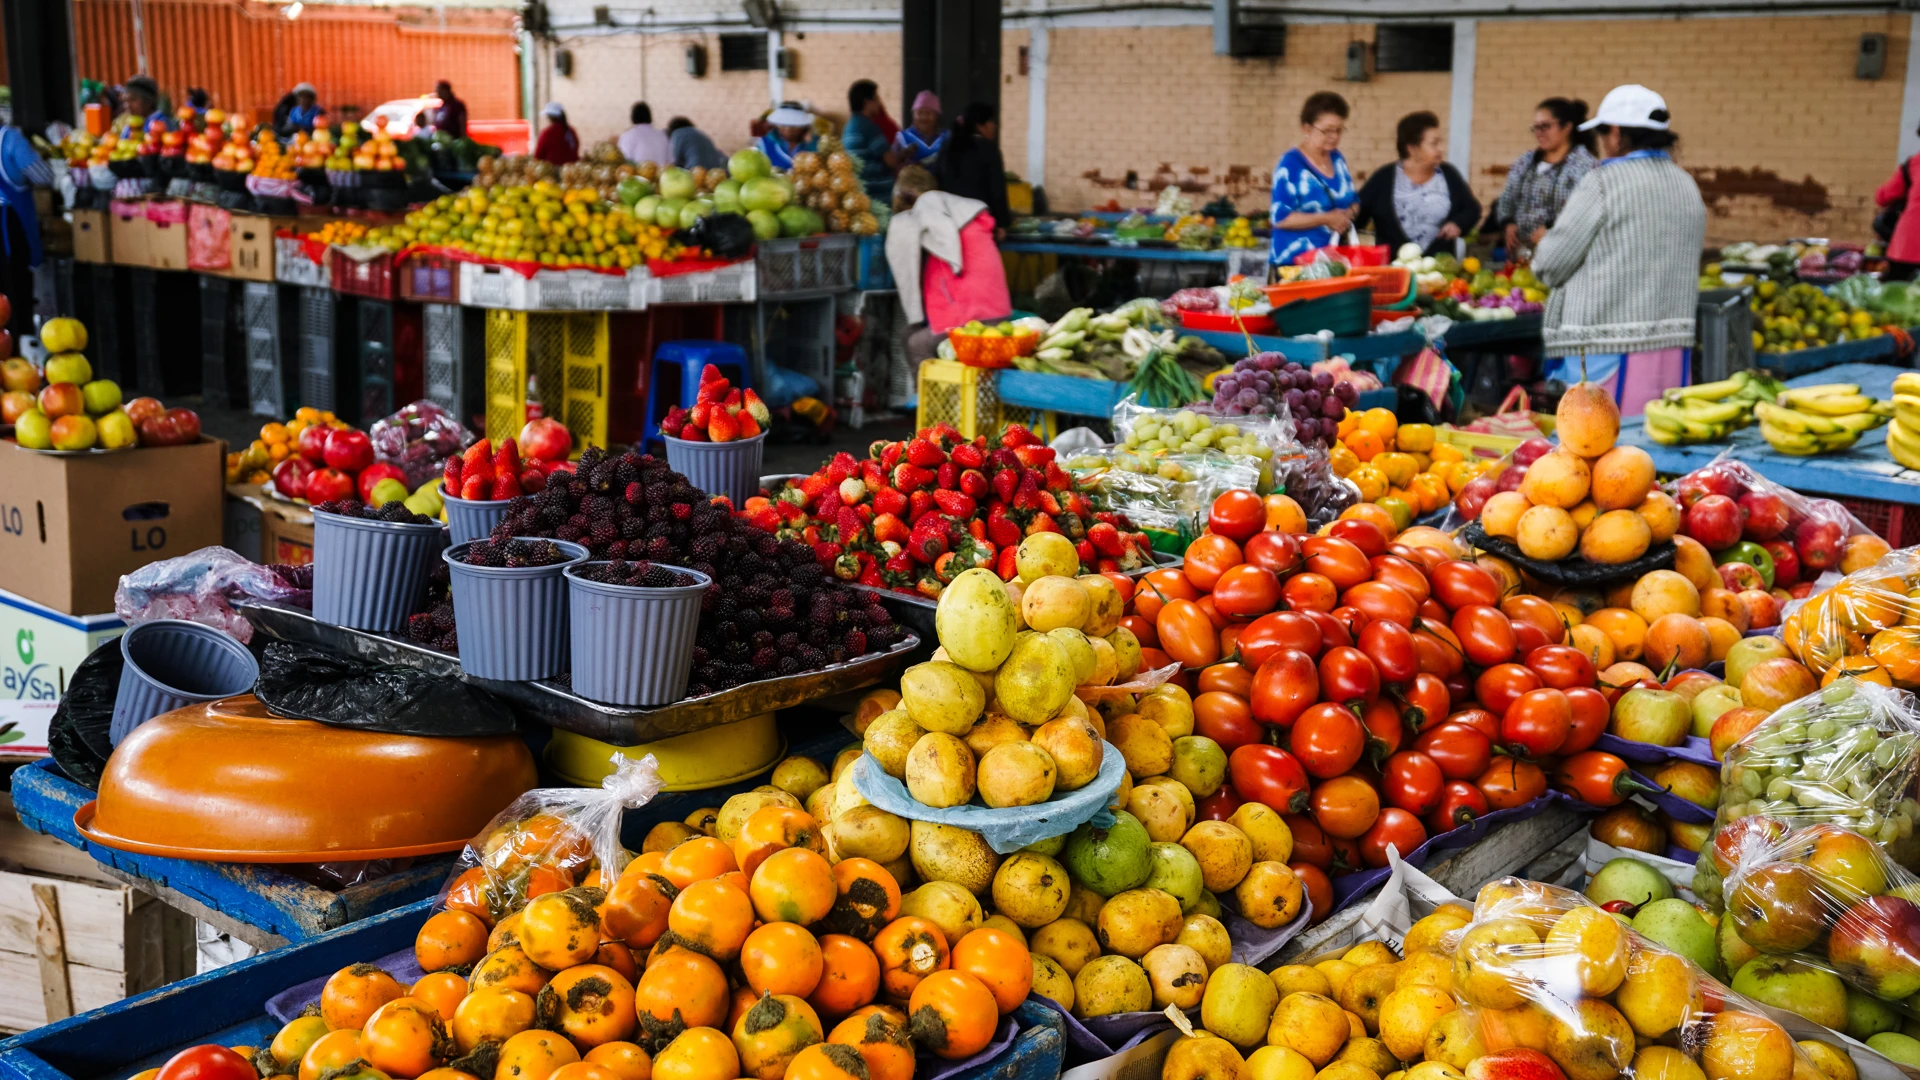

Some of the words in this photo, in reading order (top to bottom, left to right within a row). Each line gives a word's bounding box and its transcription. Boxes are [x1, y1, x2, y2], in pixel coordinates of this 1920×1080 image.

[1, 504, 23, 536] LO
[131, 526, 167, 551] LO
[1, 663, 56, 700] aysa
